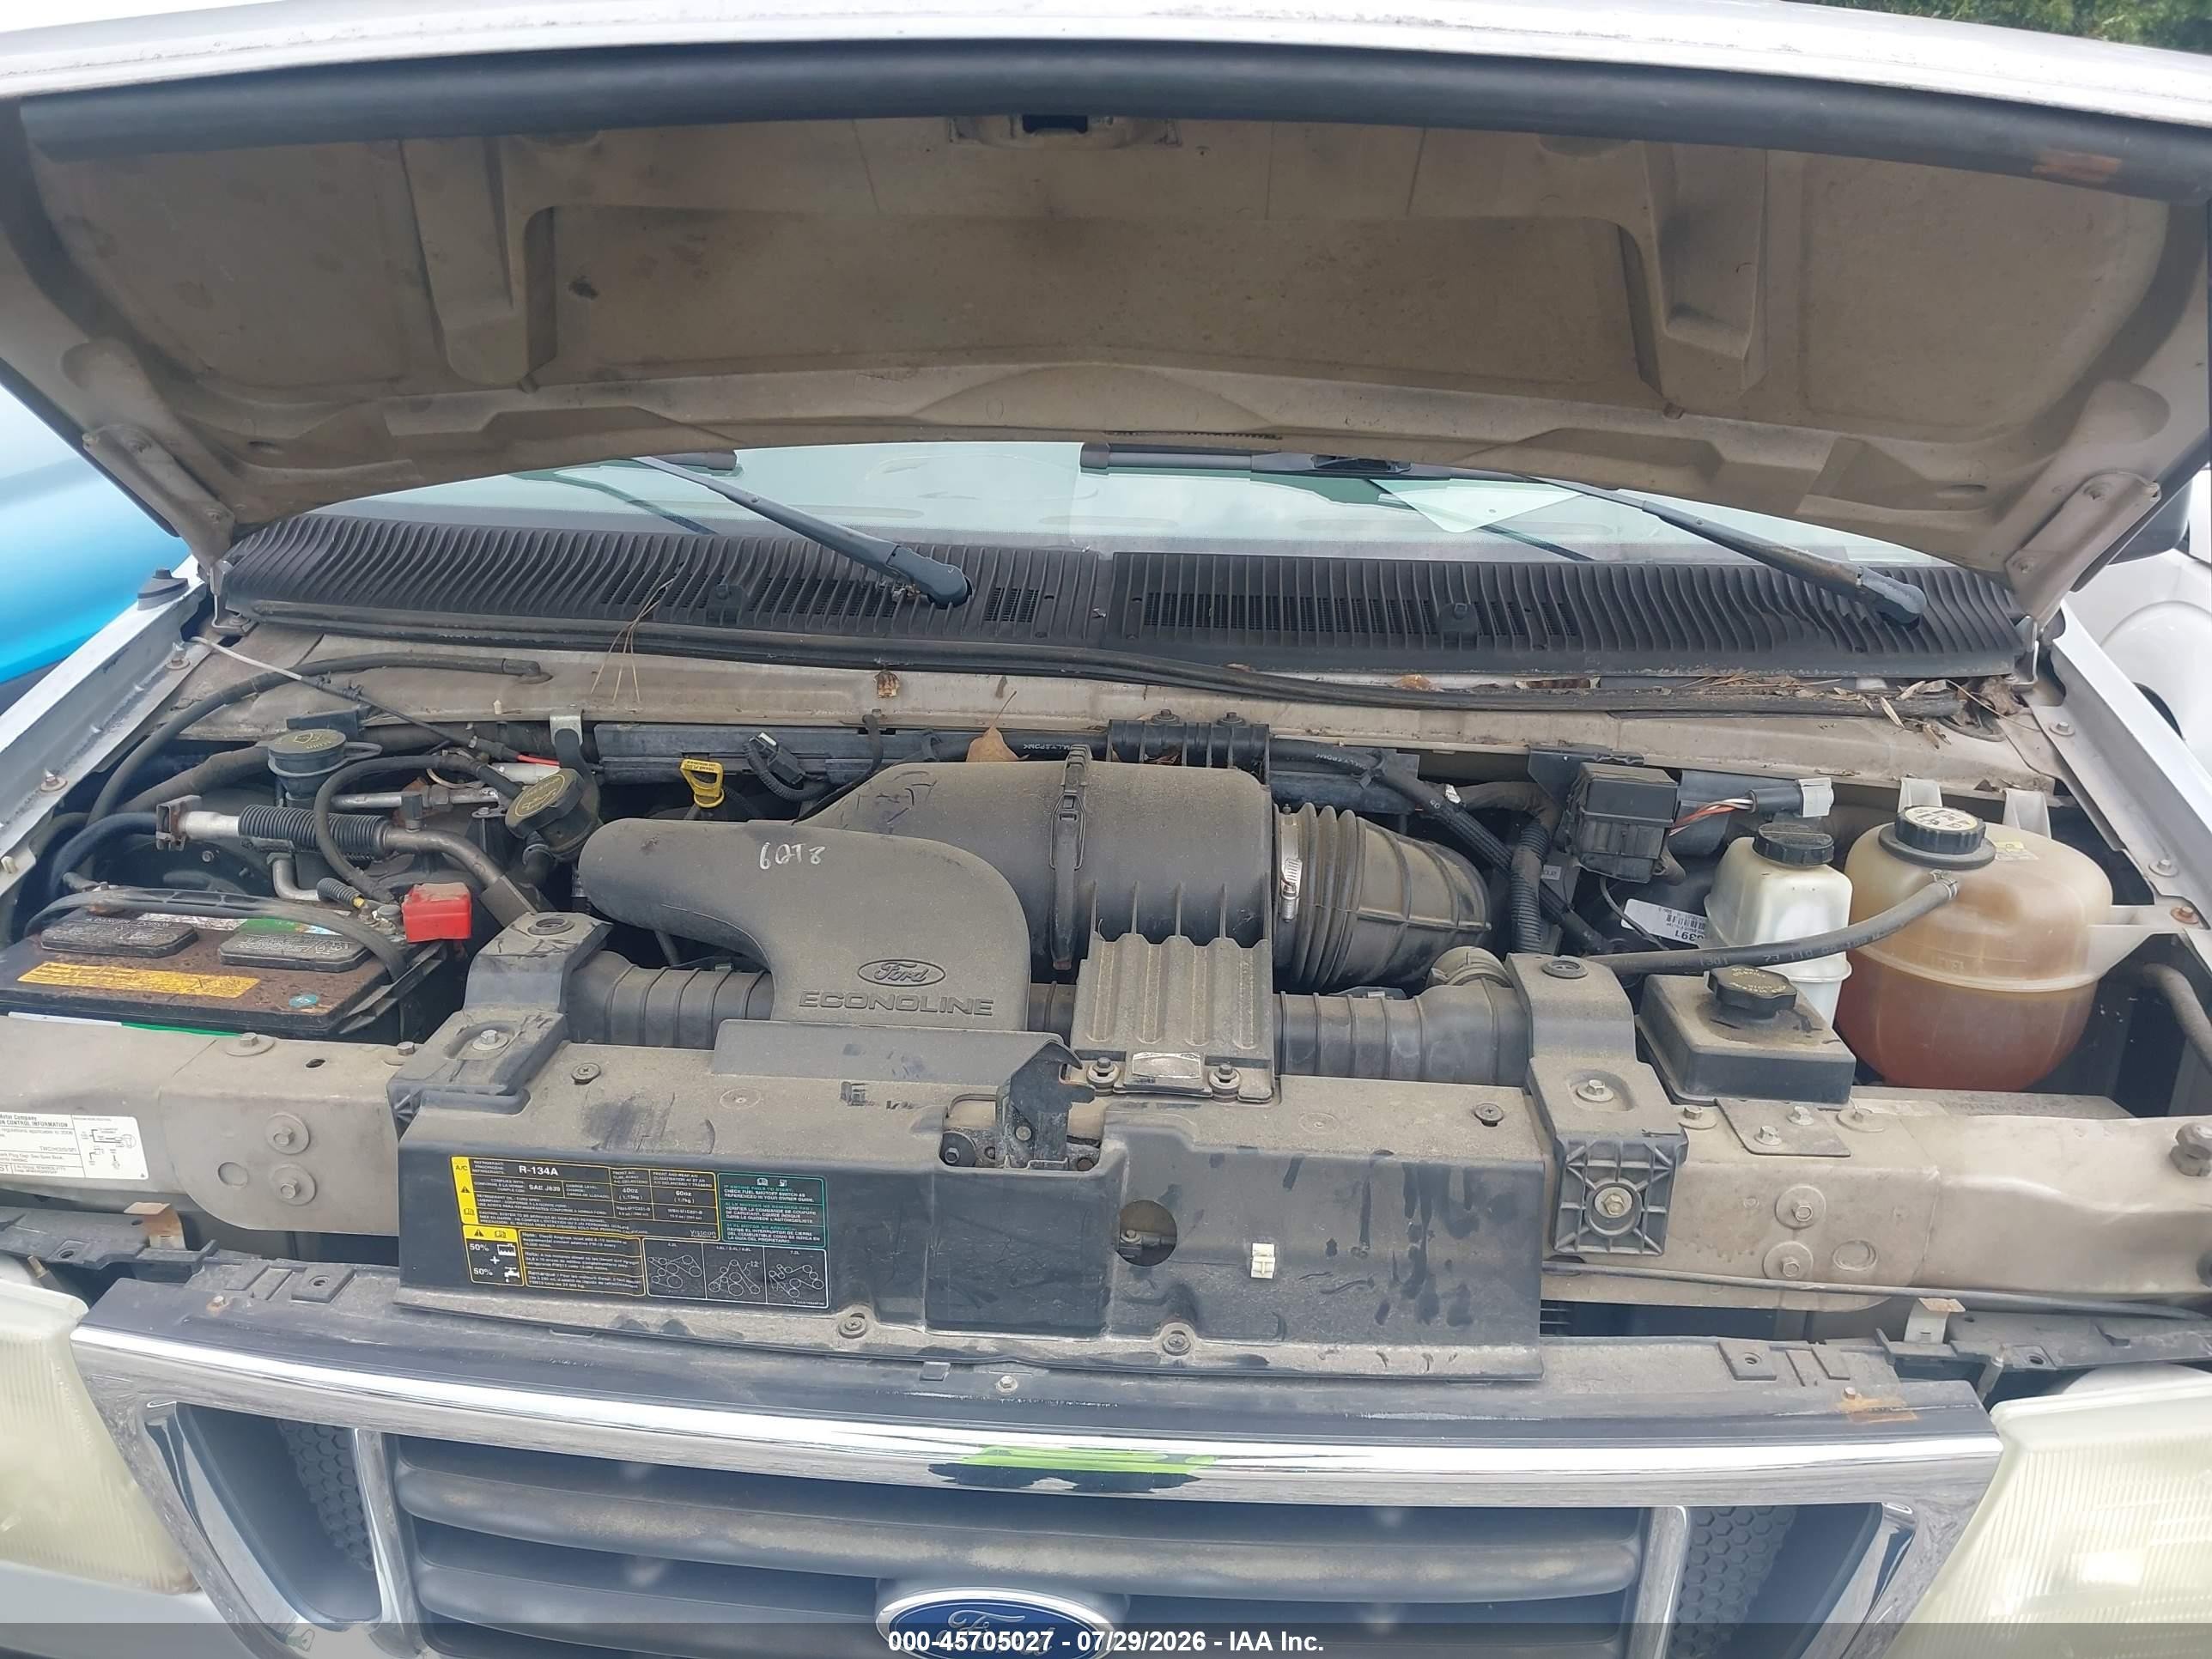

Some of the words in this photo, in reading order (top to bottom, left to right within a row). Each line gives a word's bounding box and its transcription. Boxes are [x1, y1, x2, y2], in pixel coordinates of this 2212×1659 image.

[874, 962, 929, 982] Ford
[799, 990, 994, 1016] ECONOLINE
[519, 1164, 559, 1176] R-134A
[473, 1267, 493, 1276] 50%
